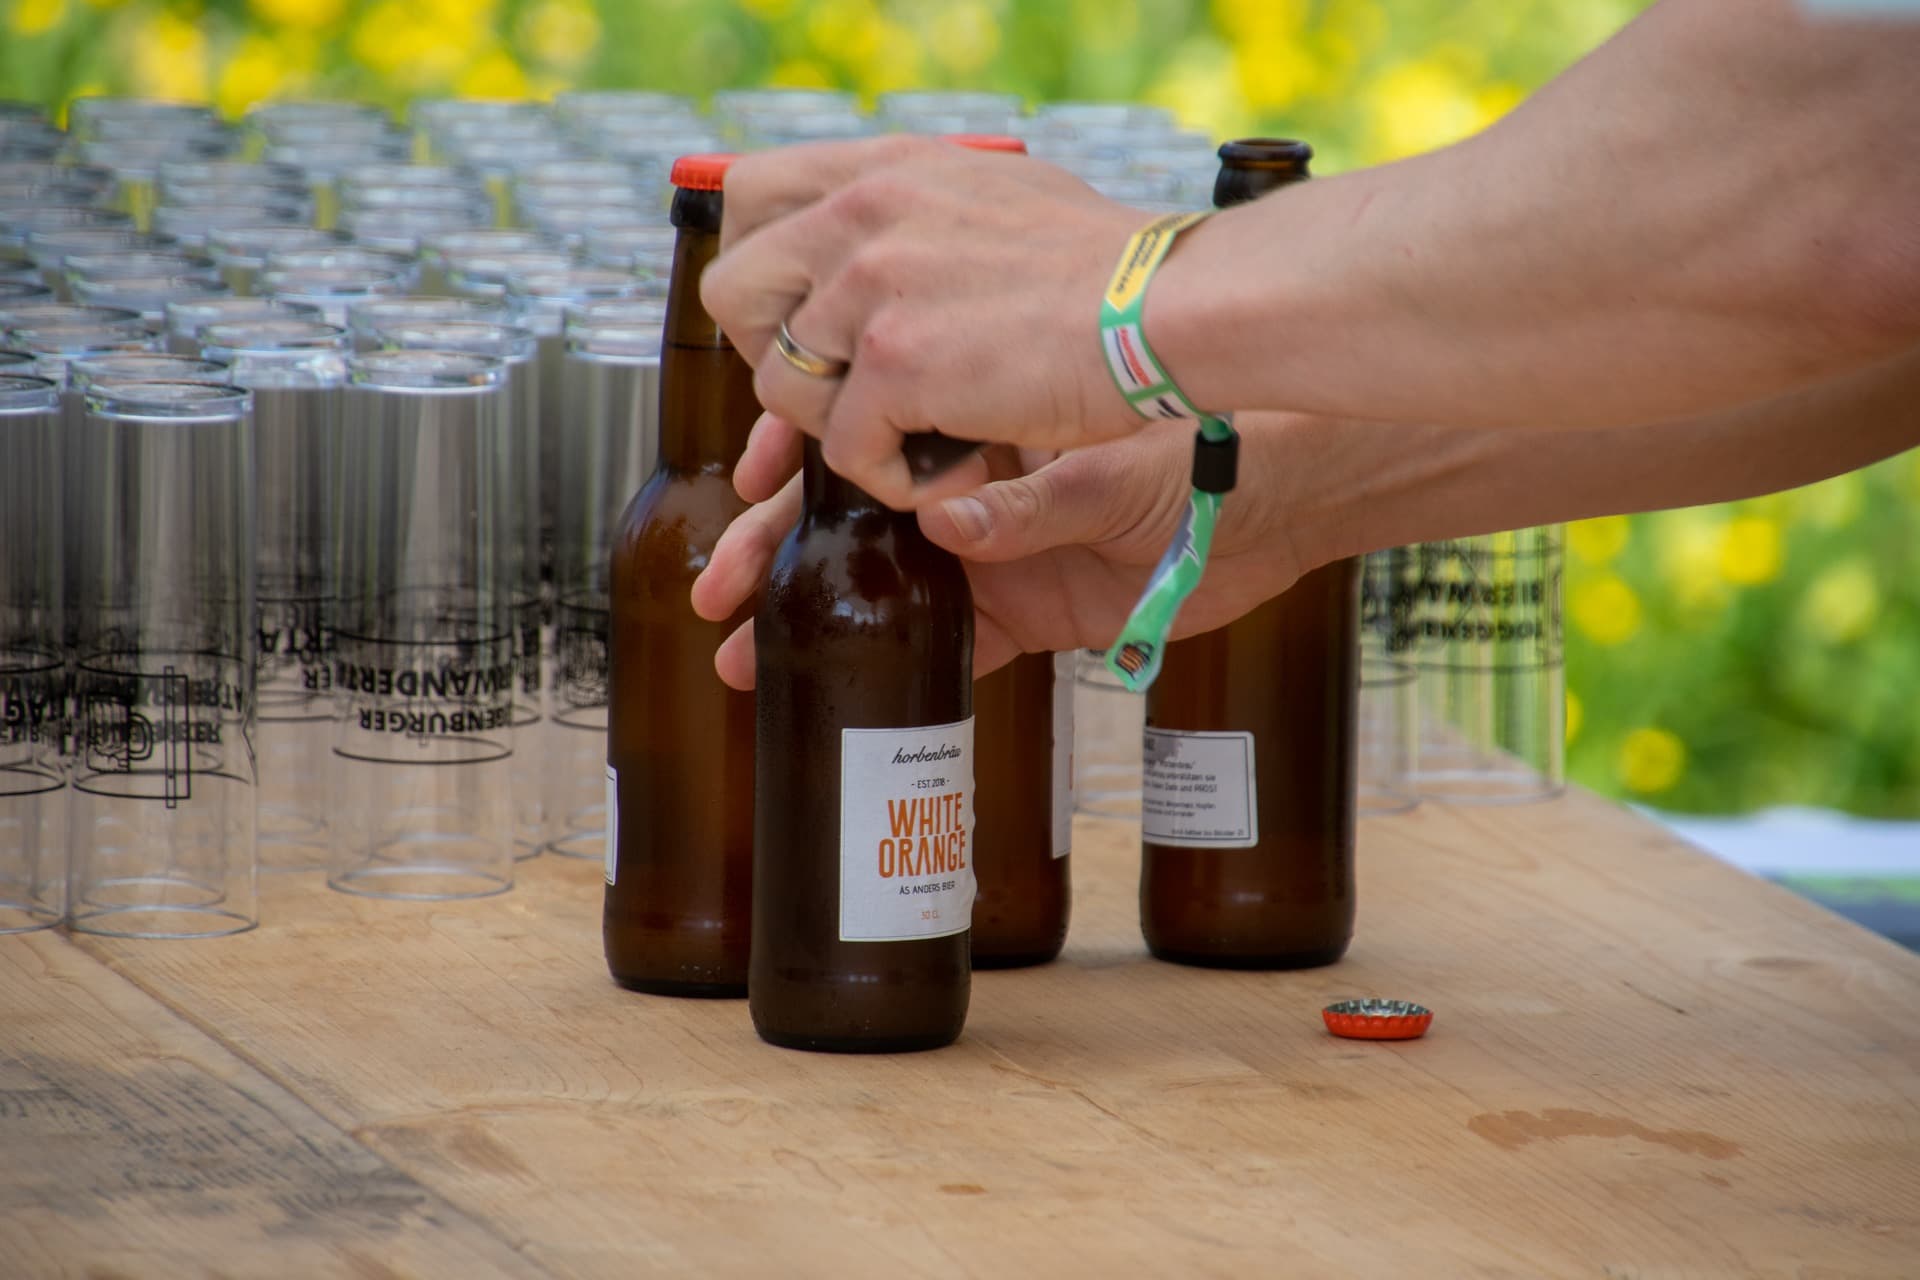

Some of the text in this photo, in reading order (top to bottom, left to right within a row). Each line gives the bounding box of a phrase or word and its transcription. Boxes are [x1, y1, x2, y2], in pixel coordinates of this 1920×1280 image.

[891, 743, 962, 765] horbenbräu
[887, 791, 963, 839] WHITE
[878, 830, 967, 878] ORANGE
[912, 882, 941, 895] ANDERS
[942, 880, 956, 891] BIER
